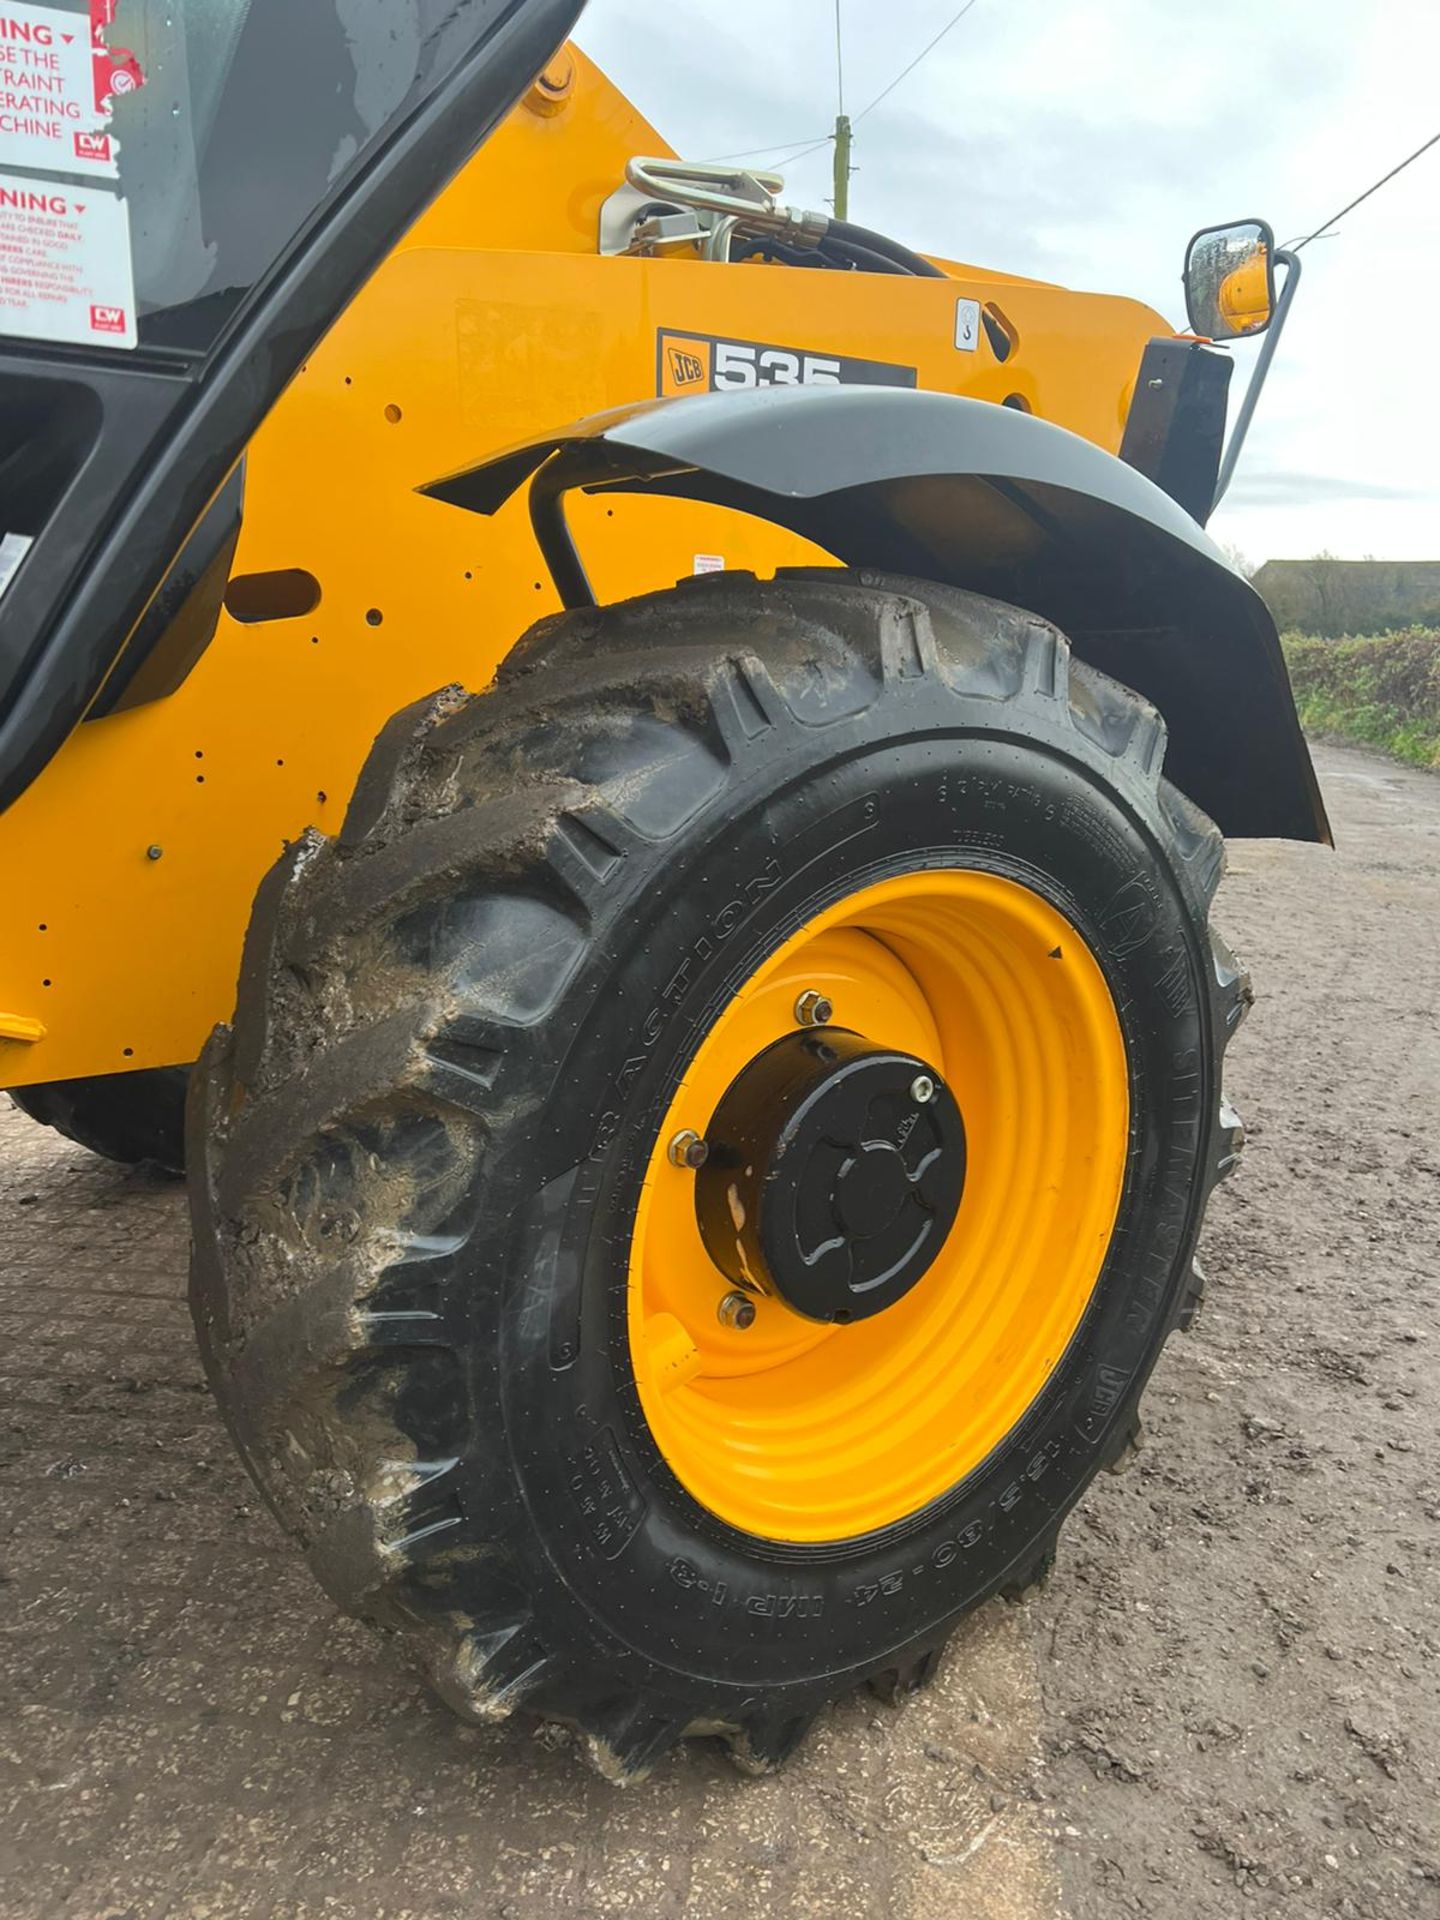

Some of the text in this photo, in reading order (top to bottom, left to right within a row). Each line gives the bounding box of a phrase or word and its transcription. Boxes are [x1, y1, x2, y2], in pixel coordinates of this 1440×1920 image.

[20, 49, 60, 71] THE
[674, 343, 841, 391] JCB 535
